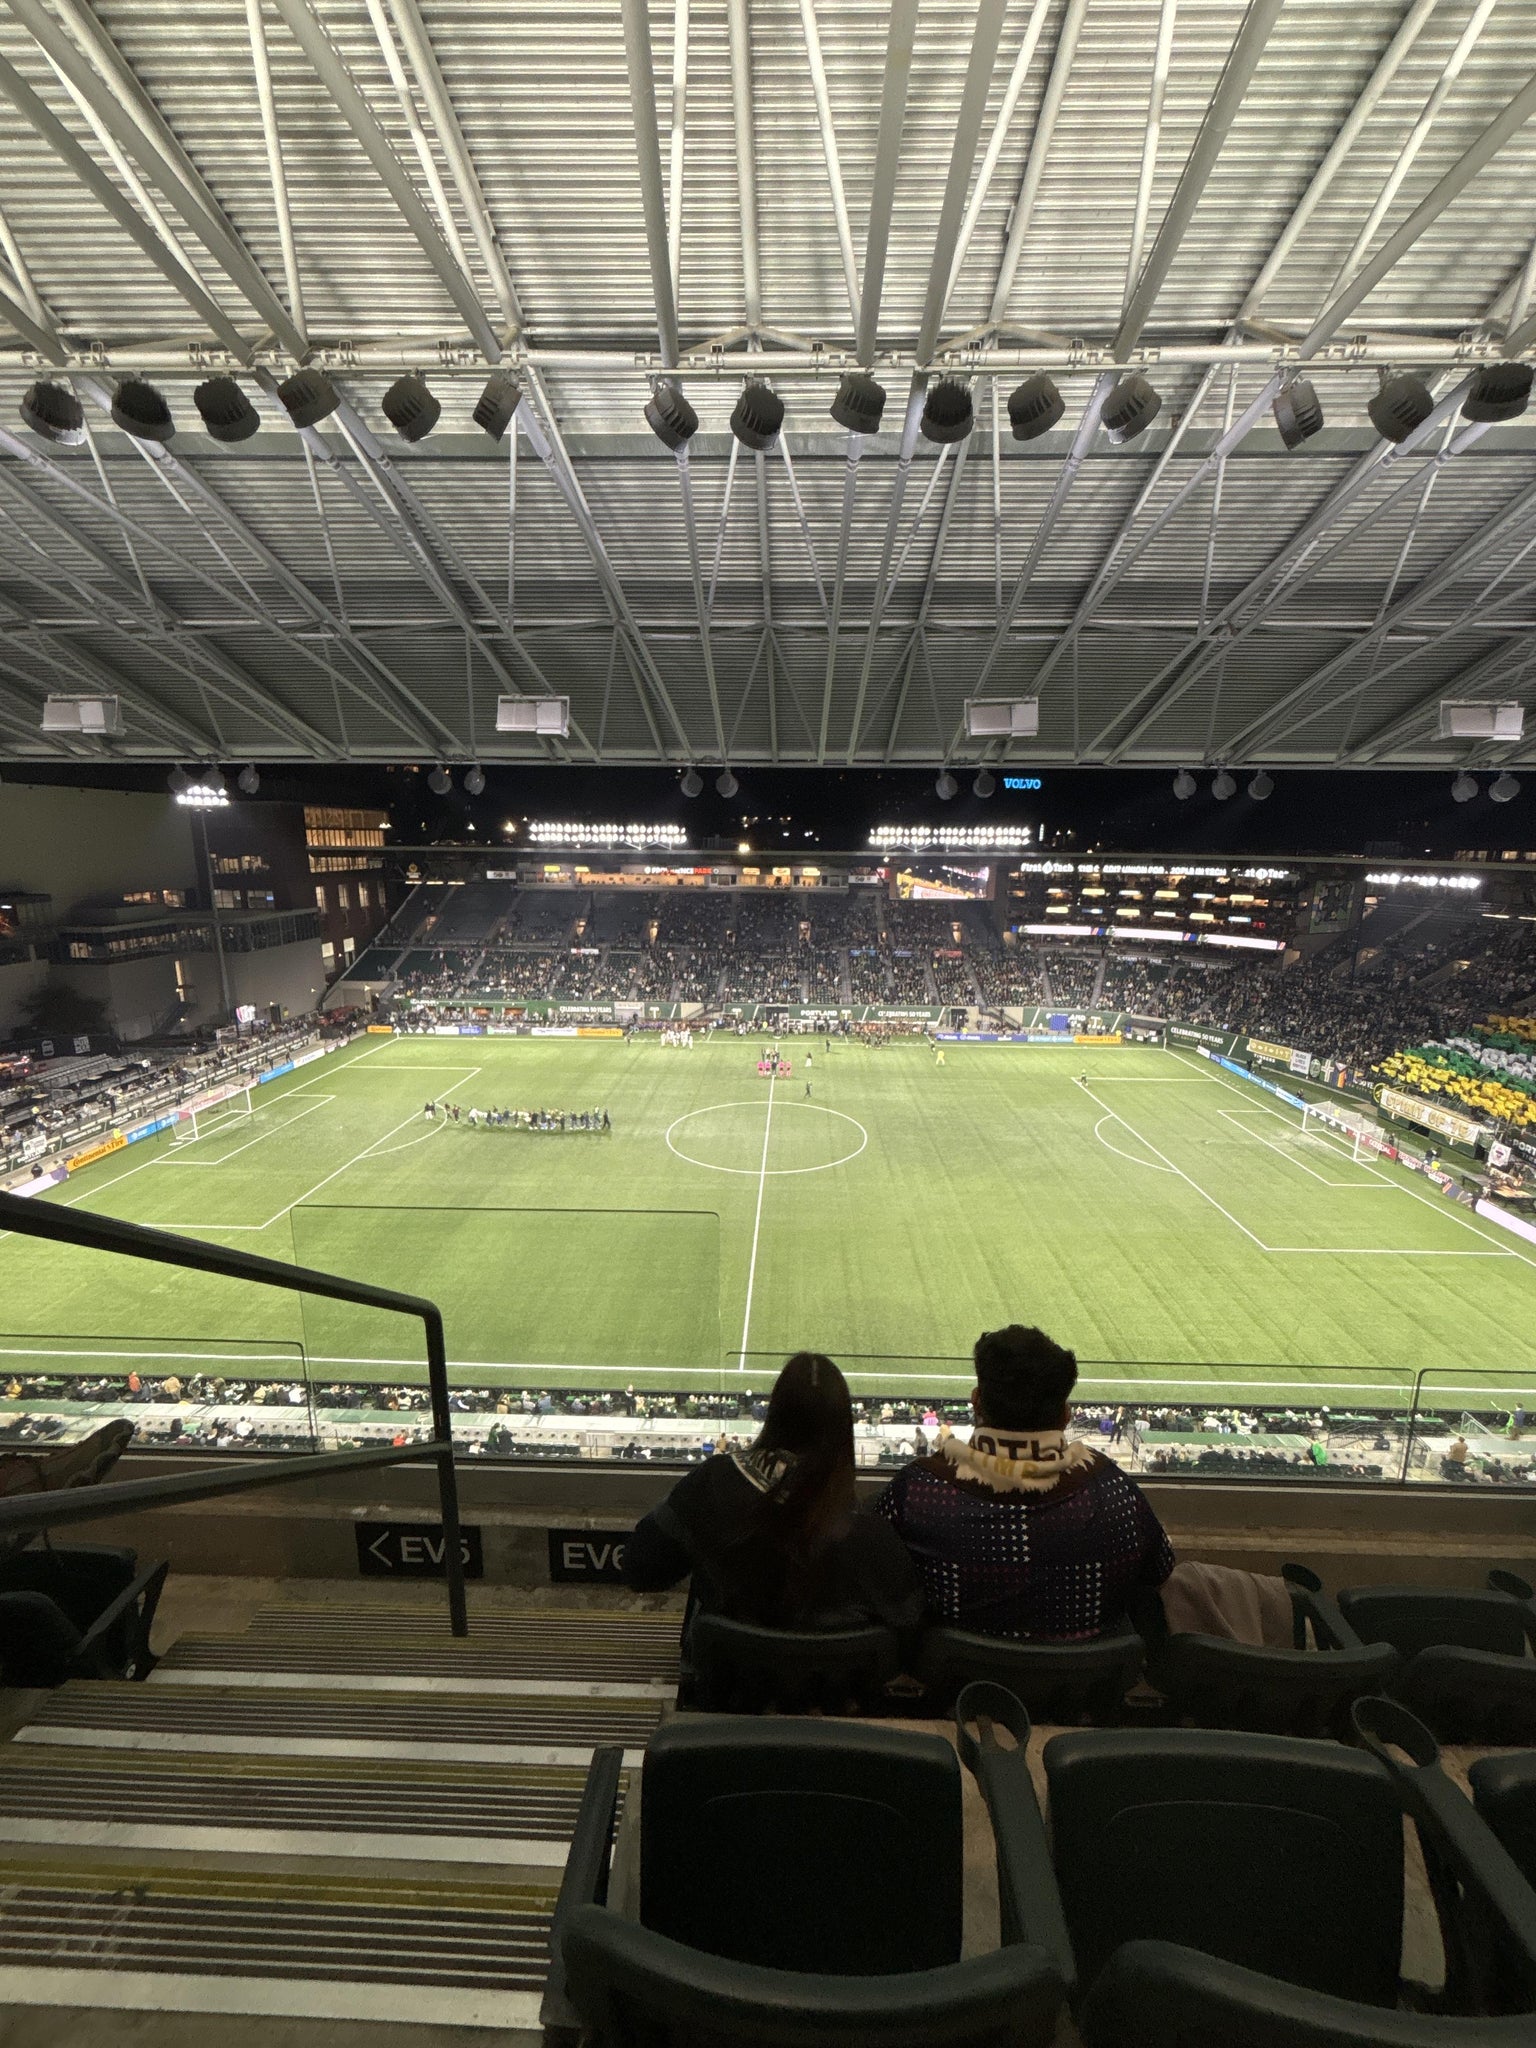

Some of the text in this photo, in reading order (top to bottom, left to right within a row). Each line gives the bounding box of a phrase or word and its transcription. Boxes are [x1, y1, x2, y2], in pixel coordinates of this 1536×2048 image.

[1003, 778, 1042, 789] VOLVO
[694, 867, 712, 875] PARK
[1021, 862, 1074, 872] First Tech
[800, 1009, 838, 1017] PORTLAND
[1170, 1027, 1201, 1039] CELEBRATING
[1208, 1034, 1224, 1045] YEARS
[1385, 1093, 1424, 1120] SPIRIT
[1427, 1110, 1446, 1128] OF
[73, 1138, 124, 1167] Continental Tire
[562, 1541, 626, 1570] EV6
